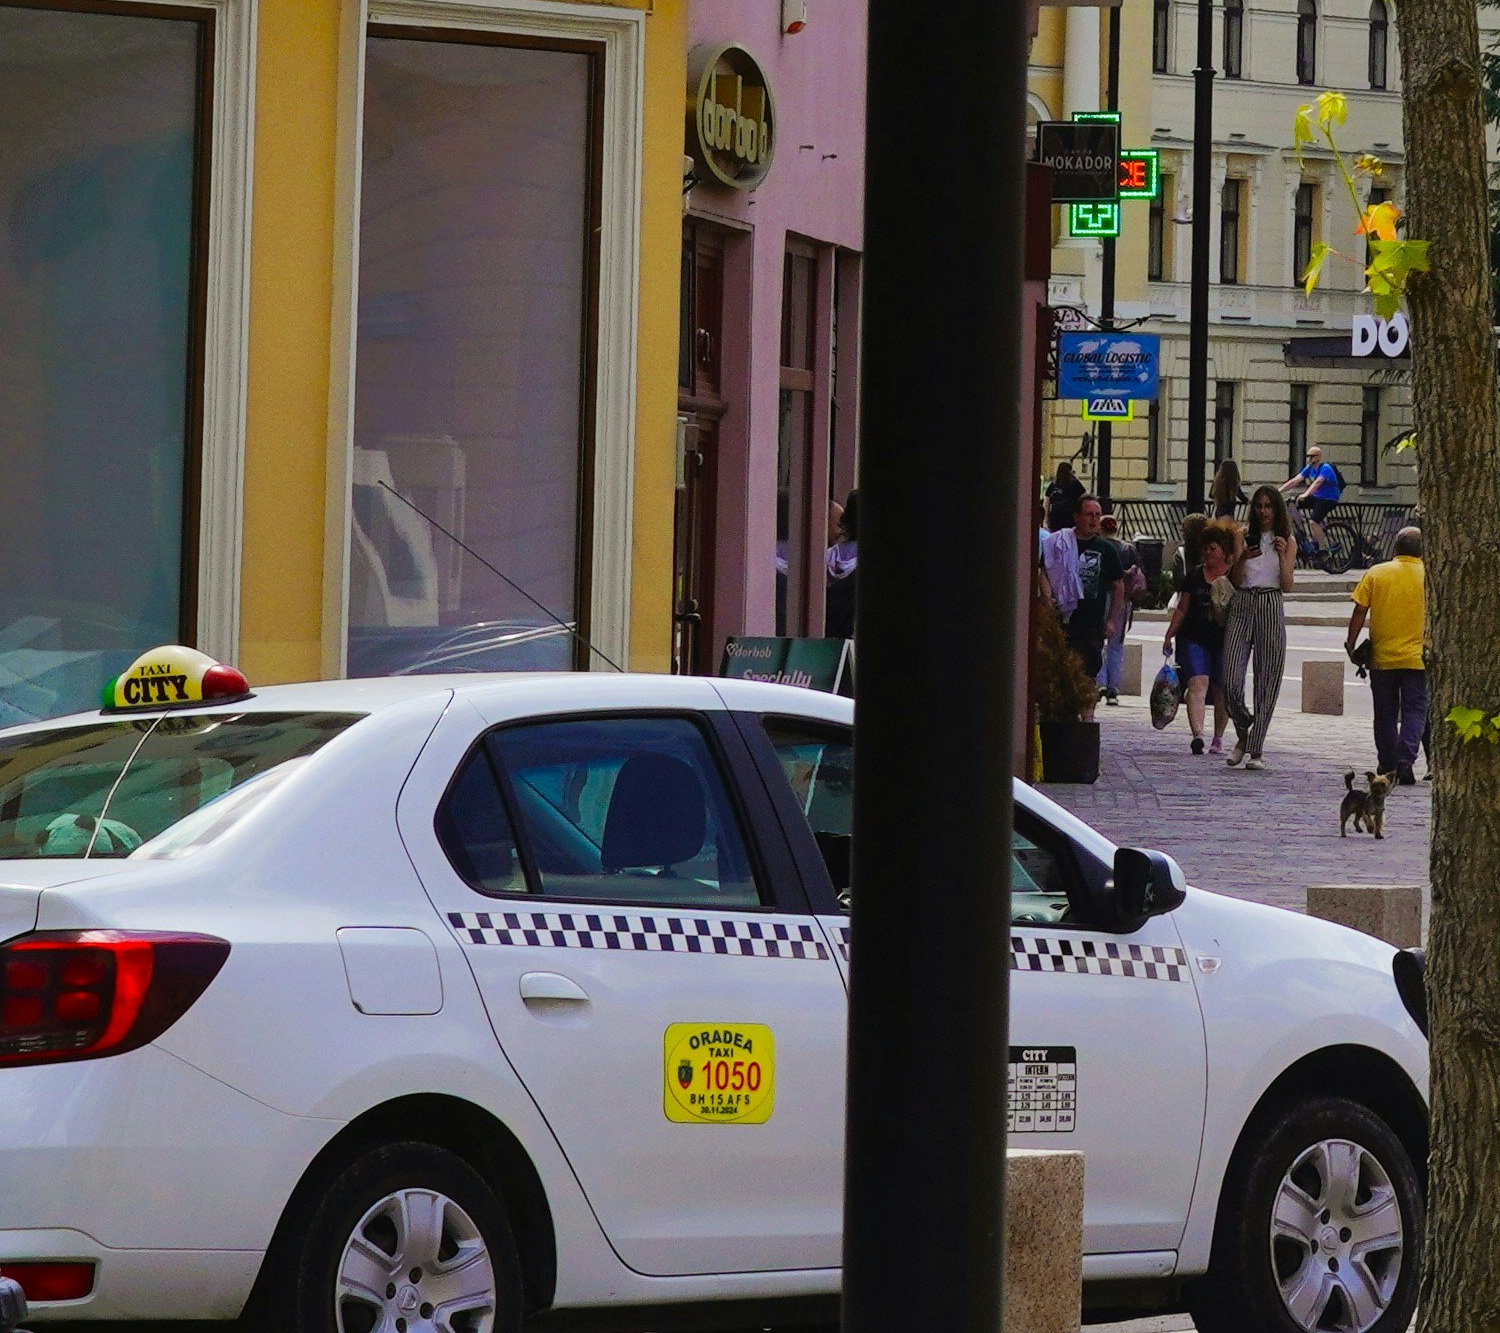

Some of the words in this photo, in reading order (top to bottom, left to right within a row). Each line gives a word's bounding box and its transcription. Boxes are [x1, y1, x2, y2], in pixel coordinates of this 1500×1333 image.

[703, 68, 768, 165] dorbob
[1045, 156, 1112, 170] MOKADOR
[1352, 313, 1411, 357] DO
[1063, 352, 1104, 363] GLOBAL
[1105, 352, 1152, 364] LOGISTIC
[736, 645, 772, 658] dorbob
[139, 664, 172, 677] TAXI
[123, 674, 190, 705] CITY
[689, 1029, 753, 1055] ORADEA
[708, 1047, 734, 1058] TAXI
[1022, 1049, 1049, 1062] CITY
[702, 1060, 762, 1092] 1050
[690, 1093, 705, 1105] BH
[710, 1093, 724, 1105] 15
[700, 1106, 738, 1115] 30.11.2024
